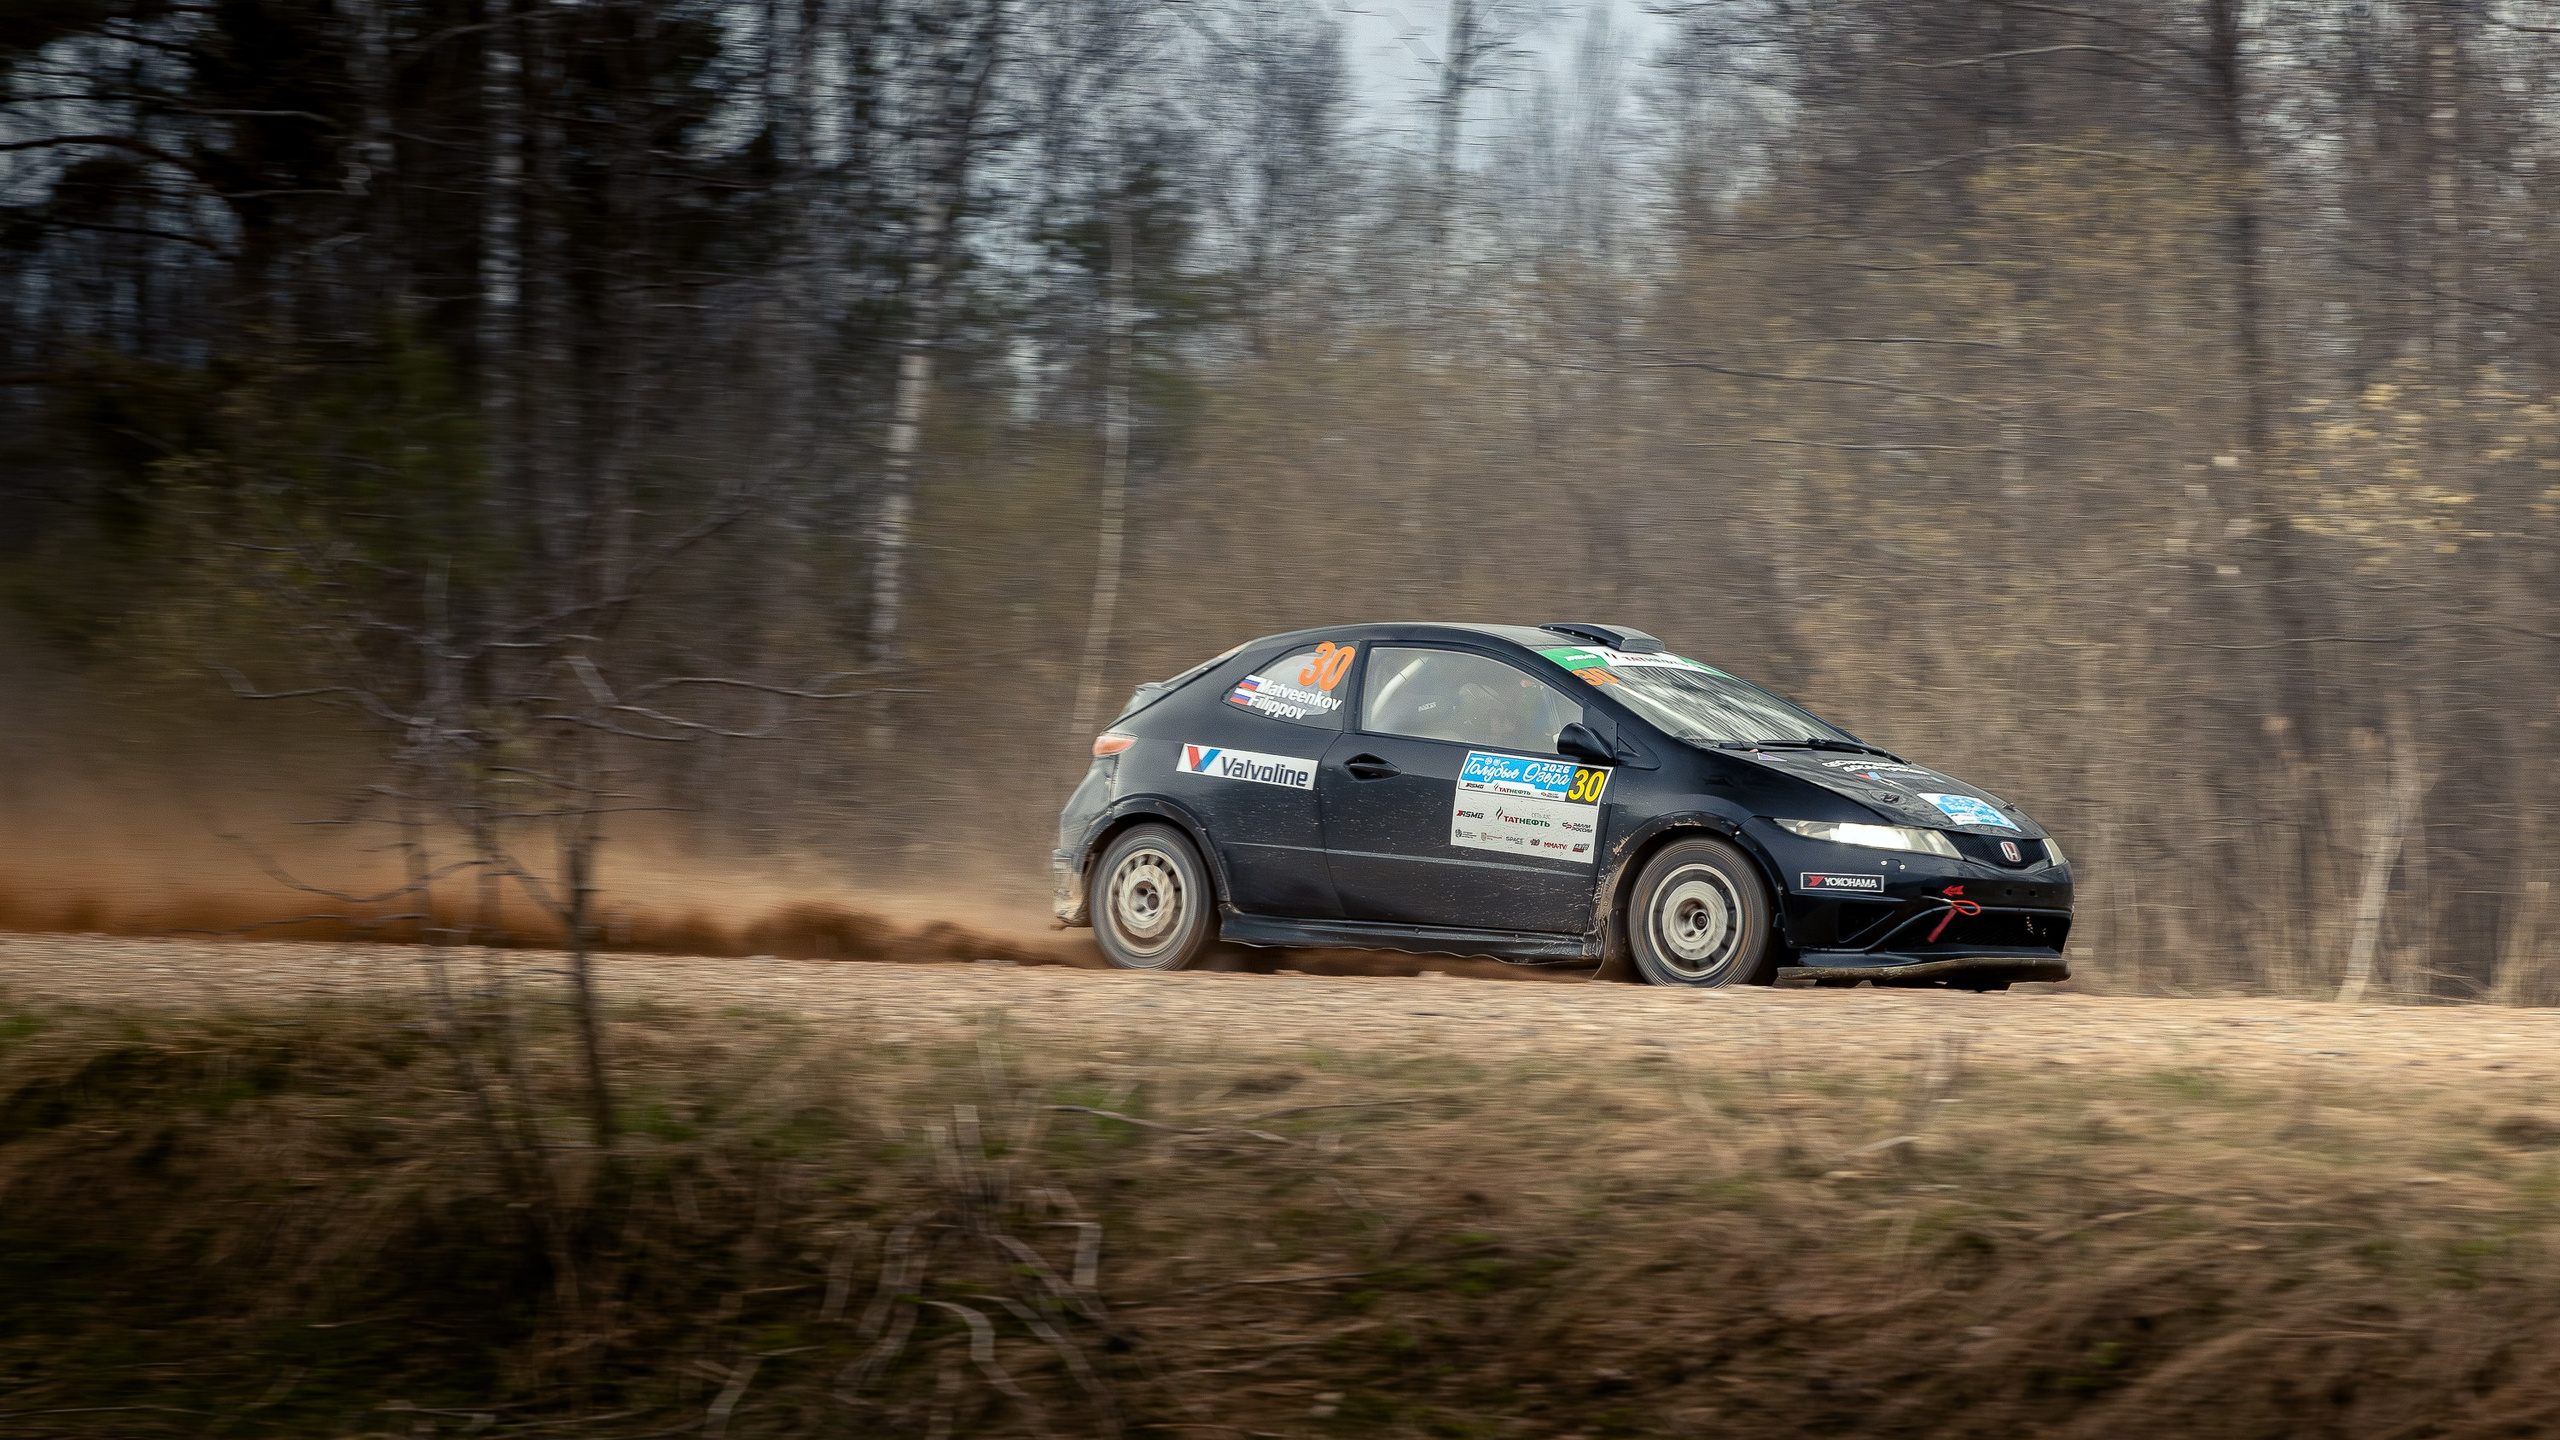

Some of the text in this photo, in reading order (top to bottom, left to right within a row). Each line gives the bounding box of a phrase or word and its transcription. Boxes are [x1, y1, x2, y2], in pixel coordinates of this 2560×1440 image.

[1298, 641, 1356, 691] 30
[1572, 668, 1619, 686] 30
[1247, 691, 1307, 720] Filippov
[1256, 679, 1343, 711] Matveenkov
[1221, 756, 1309, 787] Valvoline
[1522, 763, 1572, 790] Озера
[1542, 763, 1571, 773] 2026
[1568, 769, 1606, 802] 30
[1503, 815, 1551, 828] ТАТНЕФТЬ
[1824, 877, 1877, 888] YOKOHAMA
